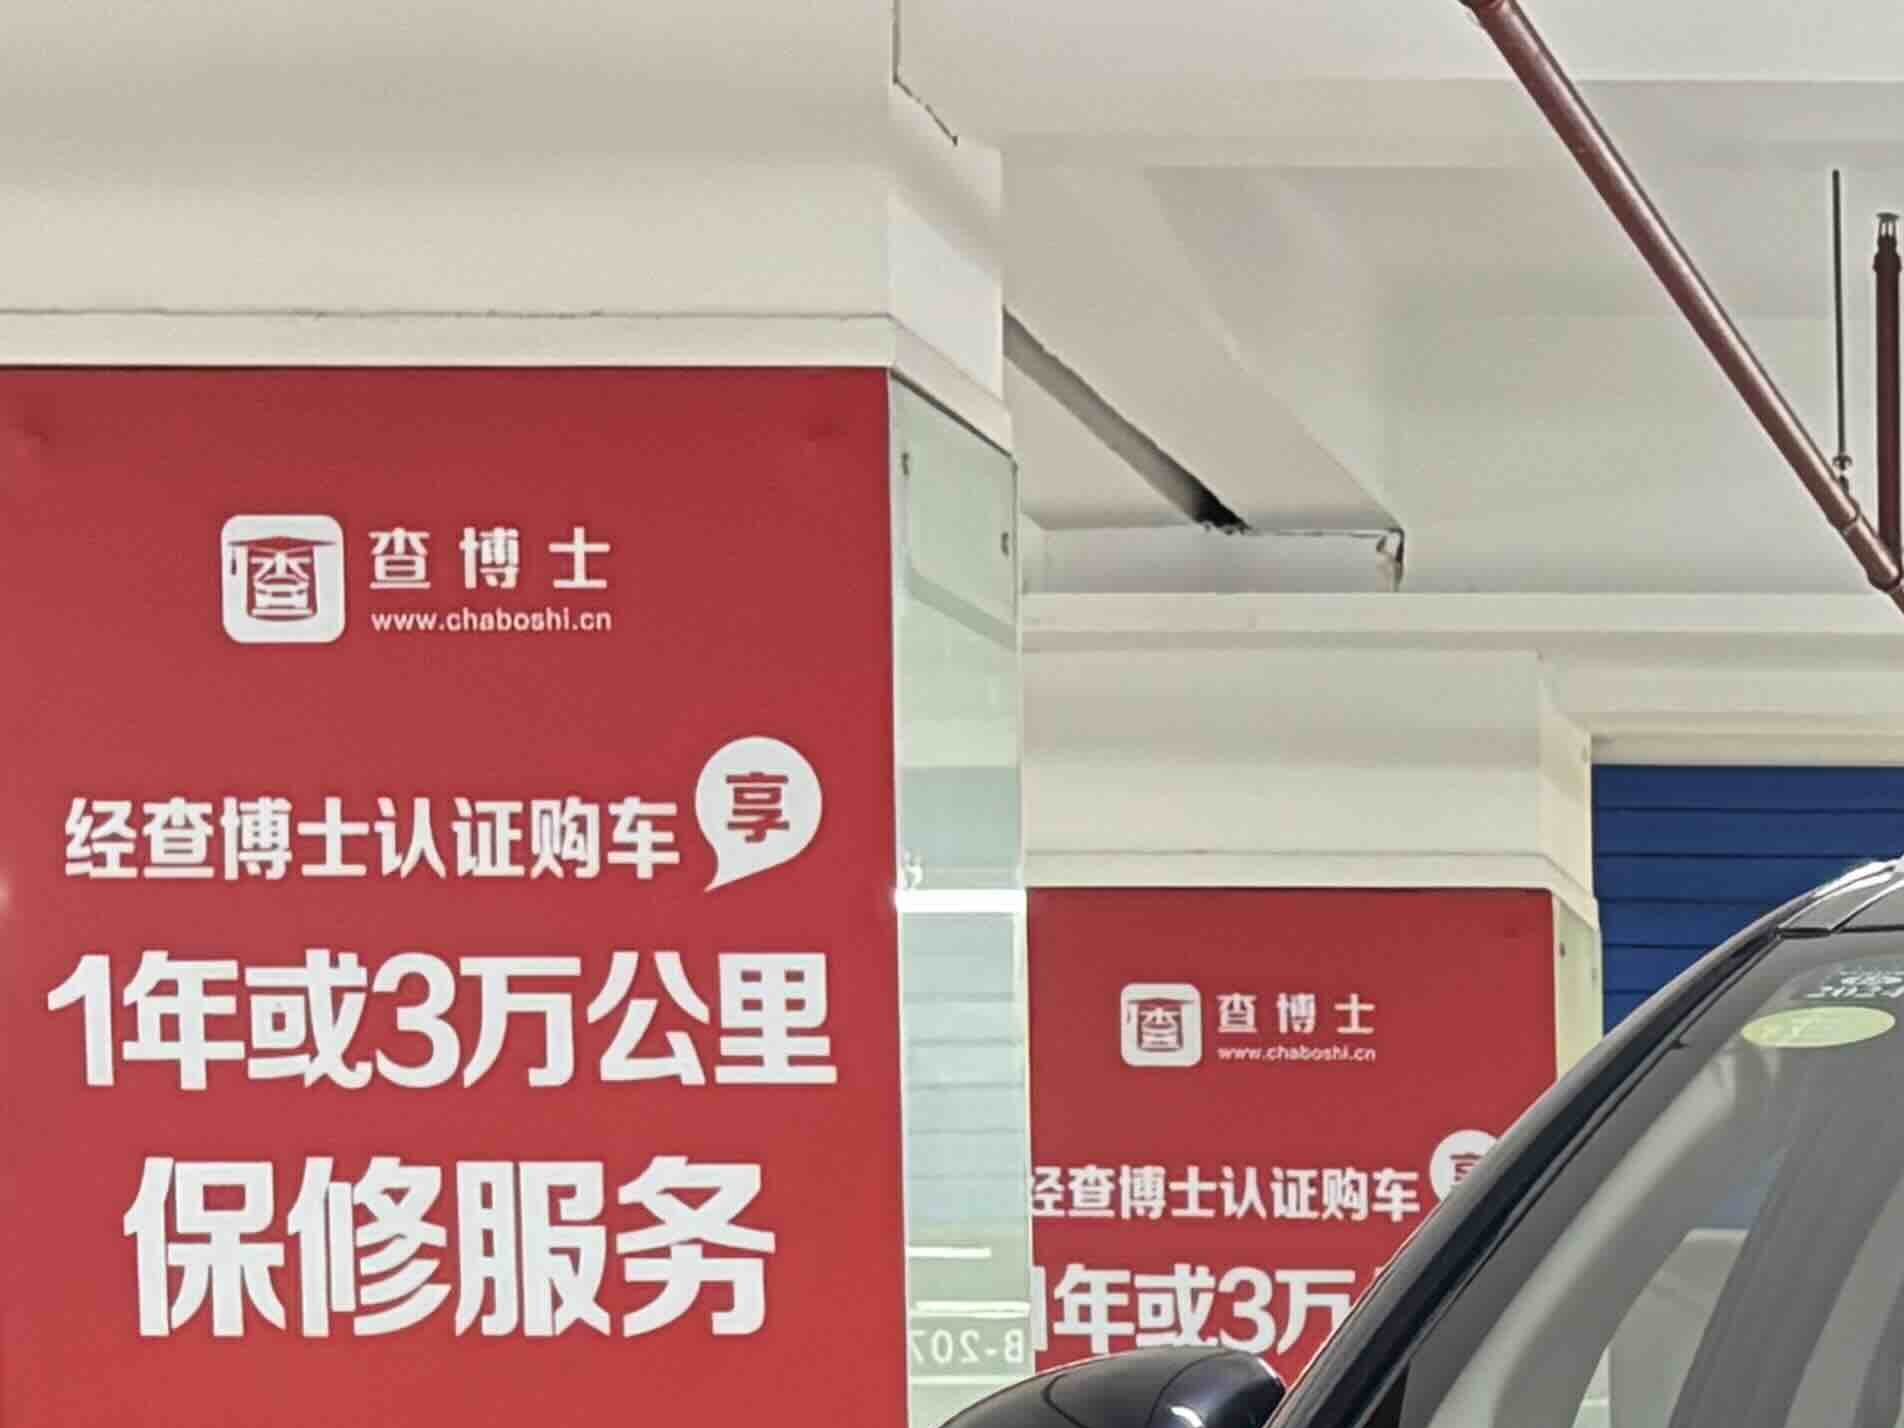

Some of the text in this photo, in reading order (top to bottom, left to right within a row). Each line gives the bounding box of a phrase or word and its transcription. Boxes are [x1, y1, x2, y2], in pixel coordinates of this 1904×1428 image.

[367, 526, 612, 591] 查博士
[370, 606, 613, 632] www.chaboshi.cn
[64, 772, 791, 881] 经查博士认证购车 享
[47, 948, 838, 1092] 1年或3万公里
[1216, 992, 1376, 1037] 查博士
[1216, 1043, 1377, 1062] www.chaboshi.cn
[122, 1154, 777, 1339] 保修服务
